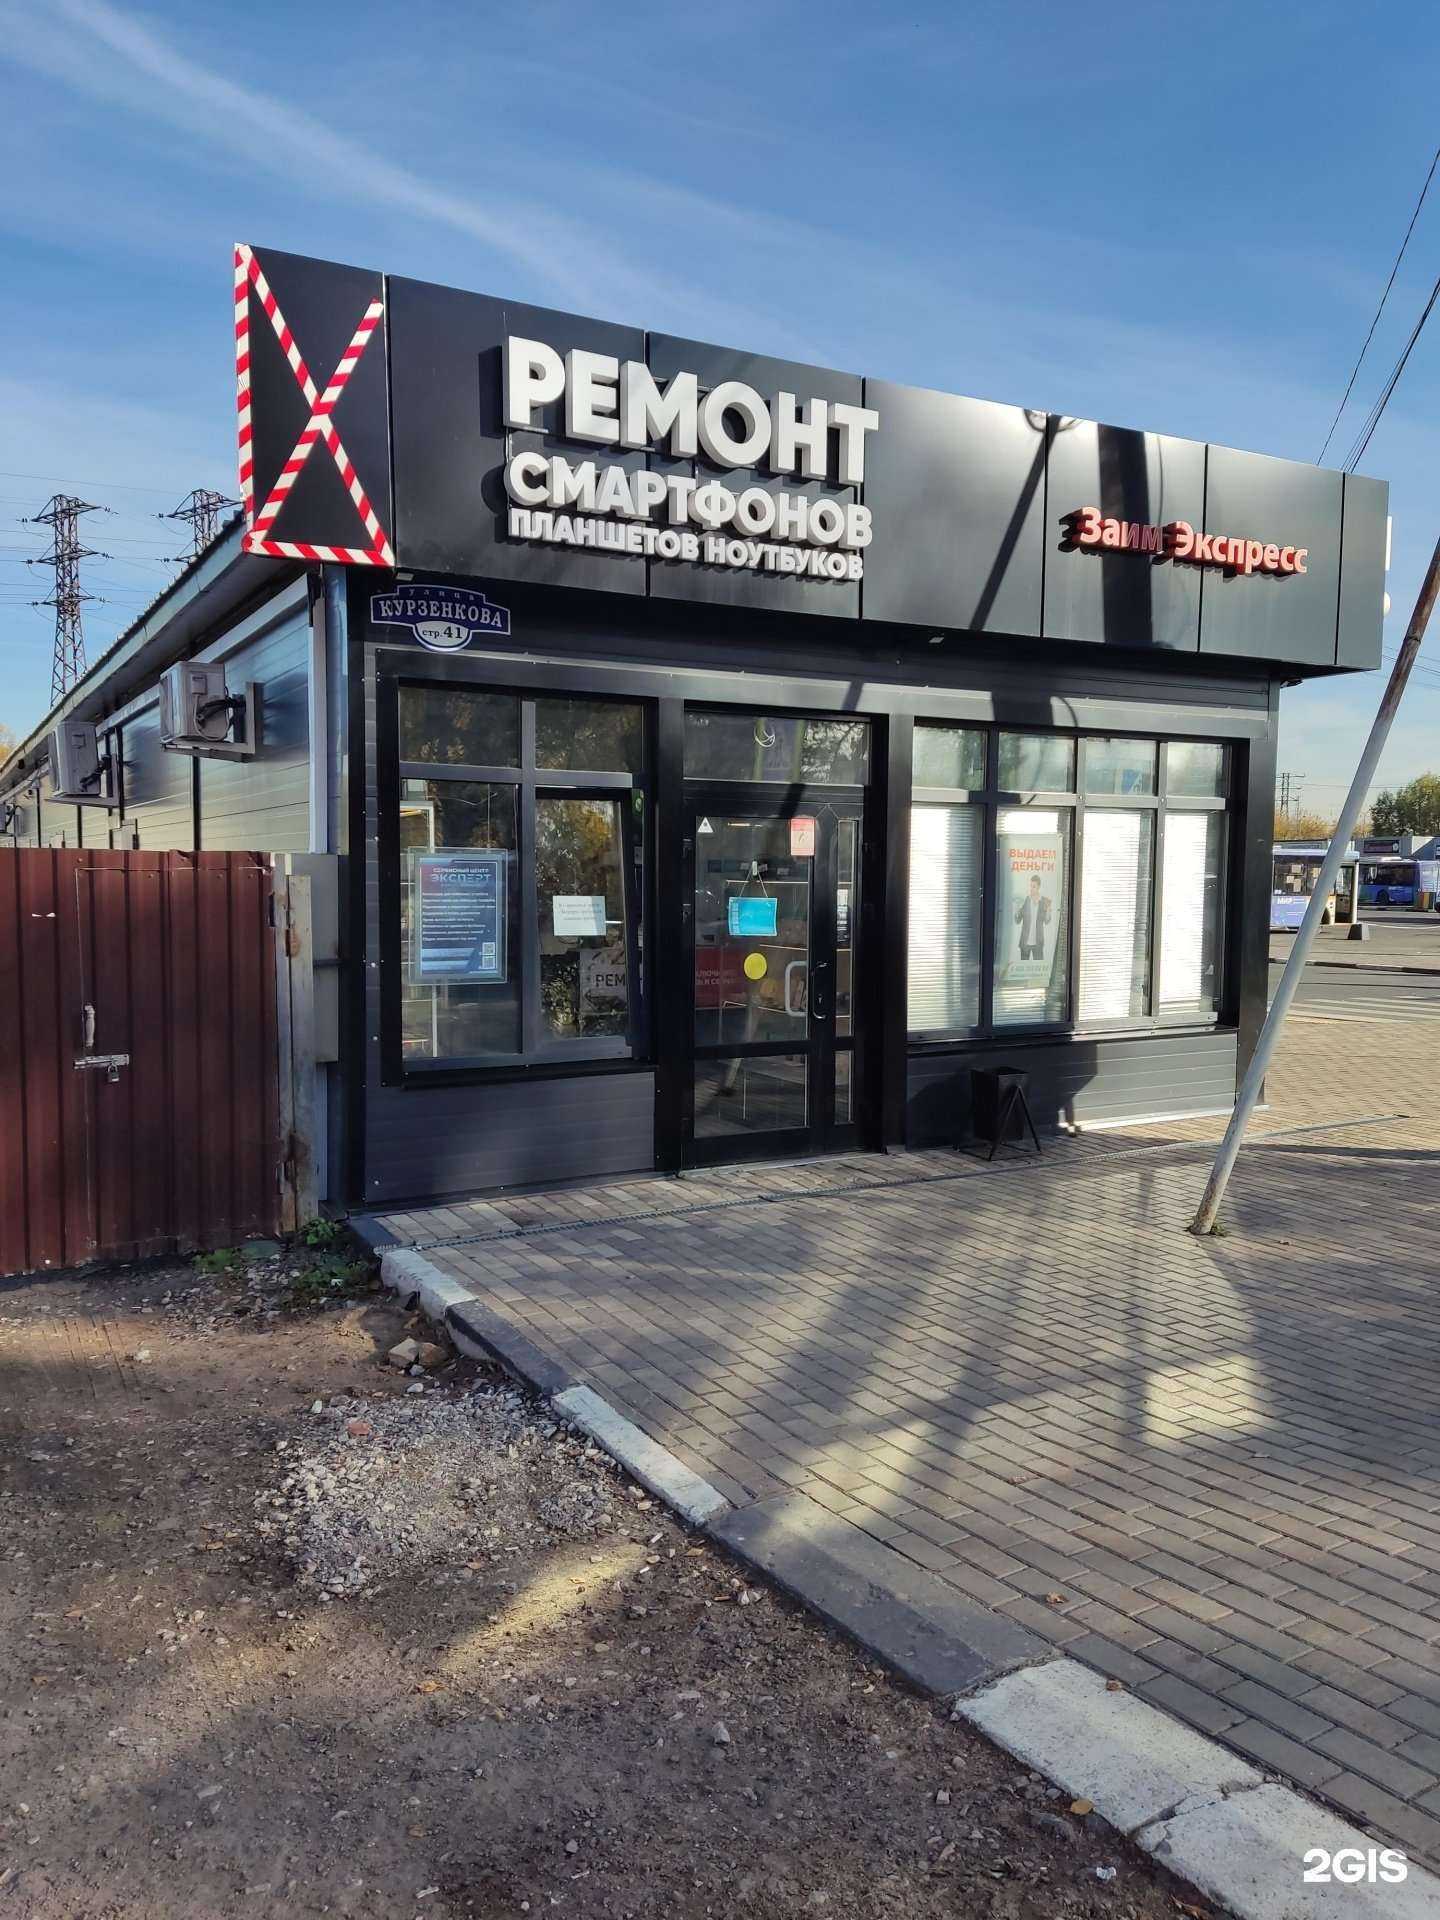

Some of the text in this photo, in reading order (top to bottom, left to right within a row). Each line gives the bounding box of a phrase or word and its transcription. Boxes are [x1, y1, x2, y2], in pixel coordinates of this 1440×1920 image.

[505, 336, 879, 484] РЕМОНТ
[505, 452, 873, 549] СМАРТФОНОВ
[509, 508, 863, 580] ПЛАНШЕТОВ НОУТБУКОВ
[1080, 507, 1308, 574] Заим Экспресс
[379, 599, 503, 628] КУРЗЕНКОВА
[431, 873, 492, 882] ЭКСПЕРТ
[1008, 848, 1056, 859] ВЫДАЕМ
[1011, 861, 1056, 872] ДЕНЬГИ
